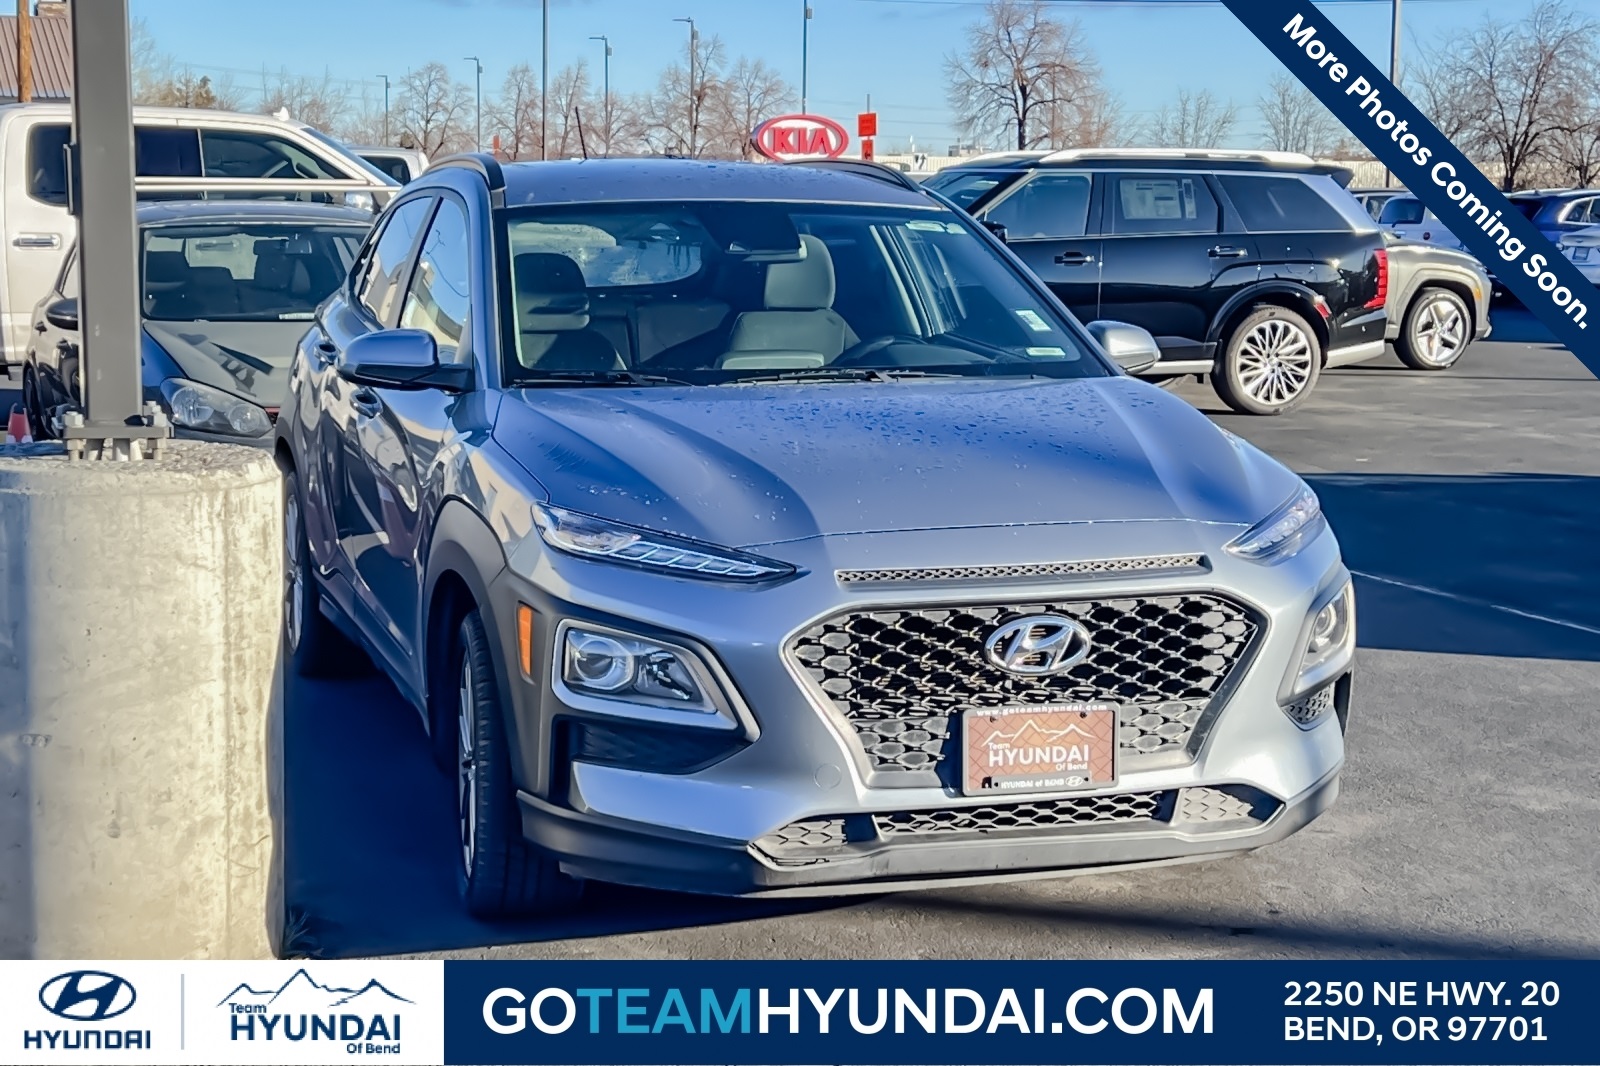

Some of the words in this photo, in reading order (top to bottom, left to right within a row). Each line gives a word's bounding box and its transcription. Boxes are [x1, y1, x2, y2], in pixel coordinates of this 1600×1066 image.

[770, 126, 833, 154] KIA
[988, 742, 1011, 750] Team
[989, 744, 1089, 767] HYUNDAI
[1055, 763, 1067, 771] Of
[1067, 762, 1088, 770] Bend
[1001, 779, 1034, 789] HYUNDAI
